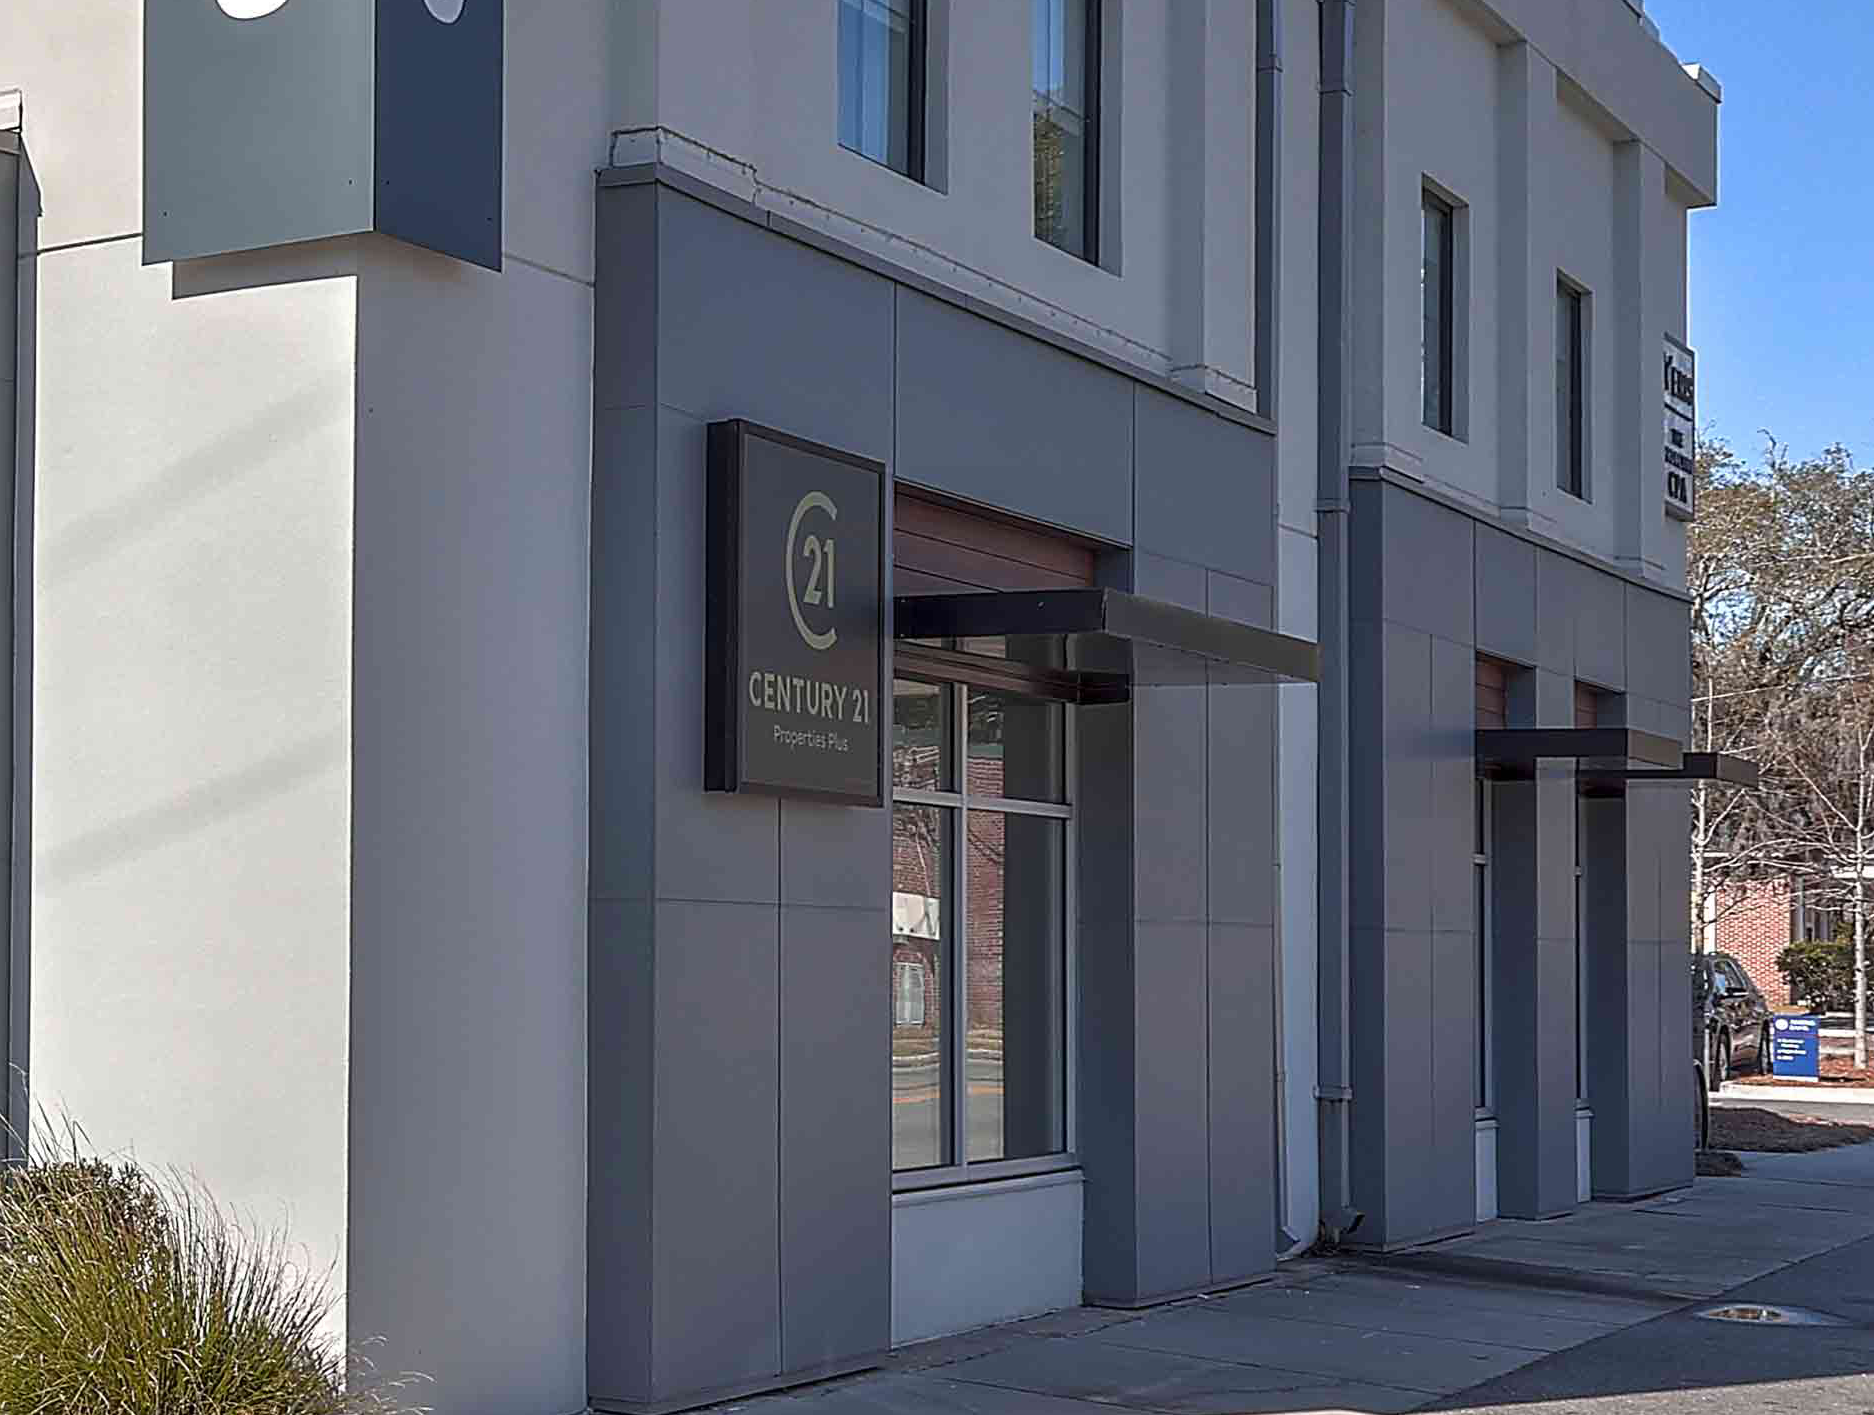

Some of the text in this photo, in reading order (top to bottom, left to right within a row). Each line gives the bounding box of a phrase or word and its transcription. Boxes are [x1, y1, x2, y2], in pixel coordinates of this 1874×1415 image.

[748, 671, 869, 724] CENTURY 21
[773, 724, 826, 753] Properties
